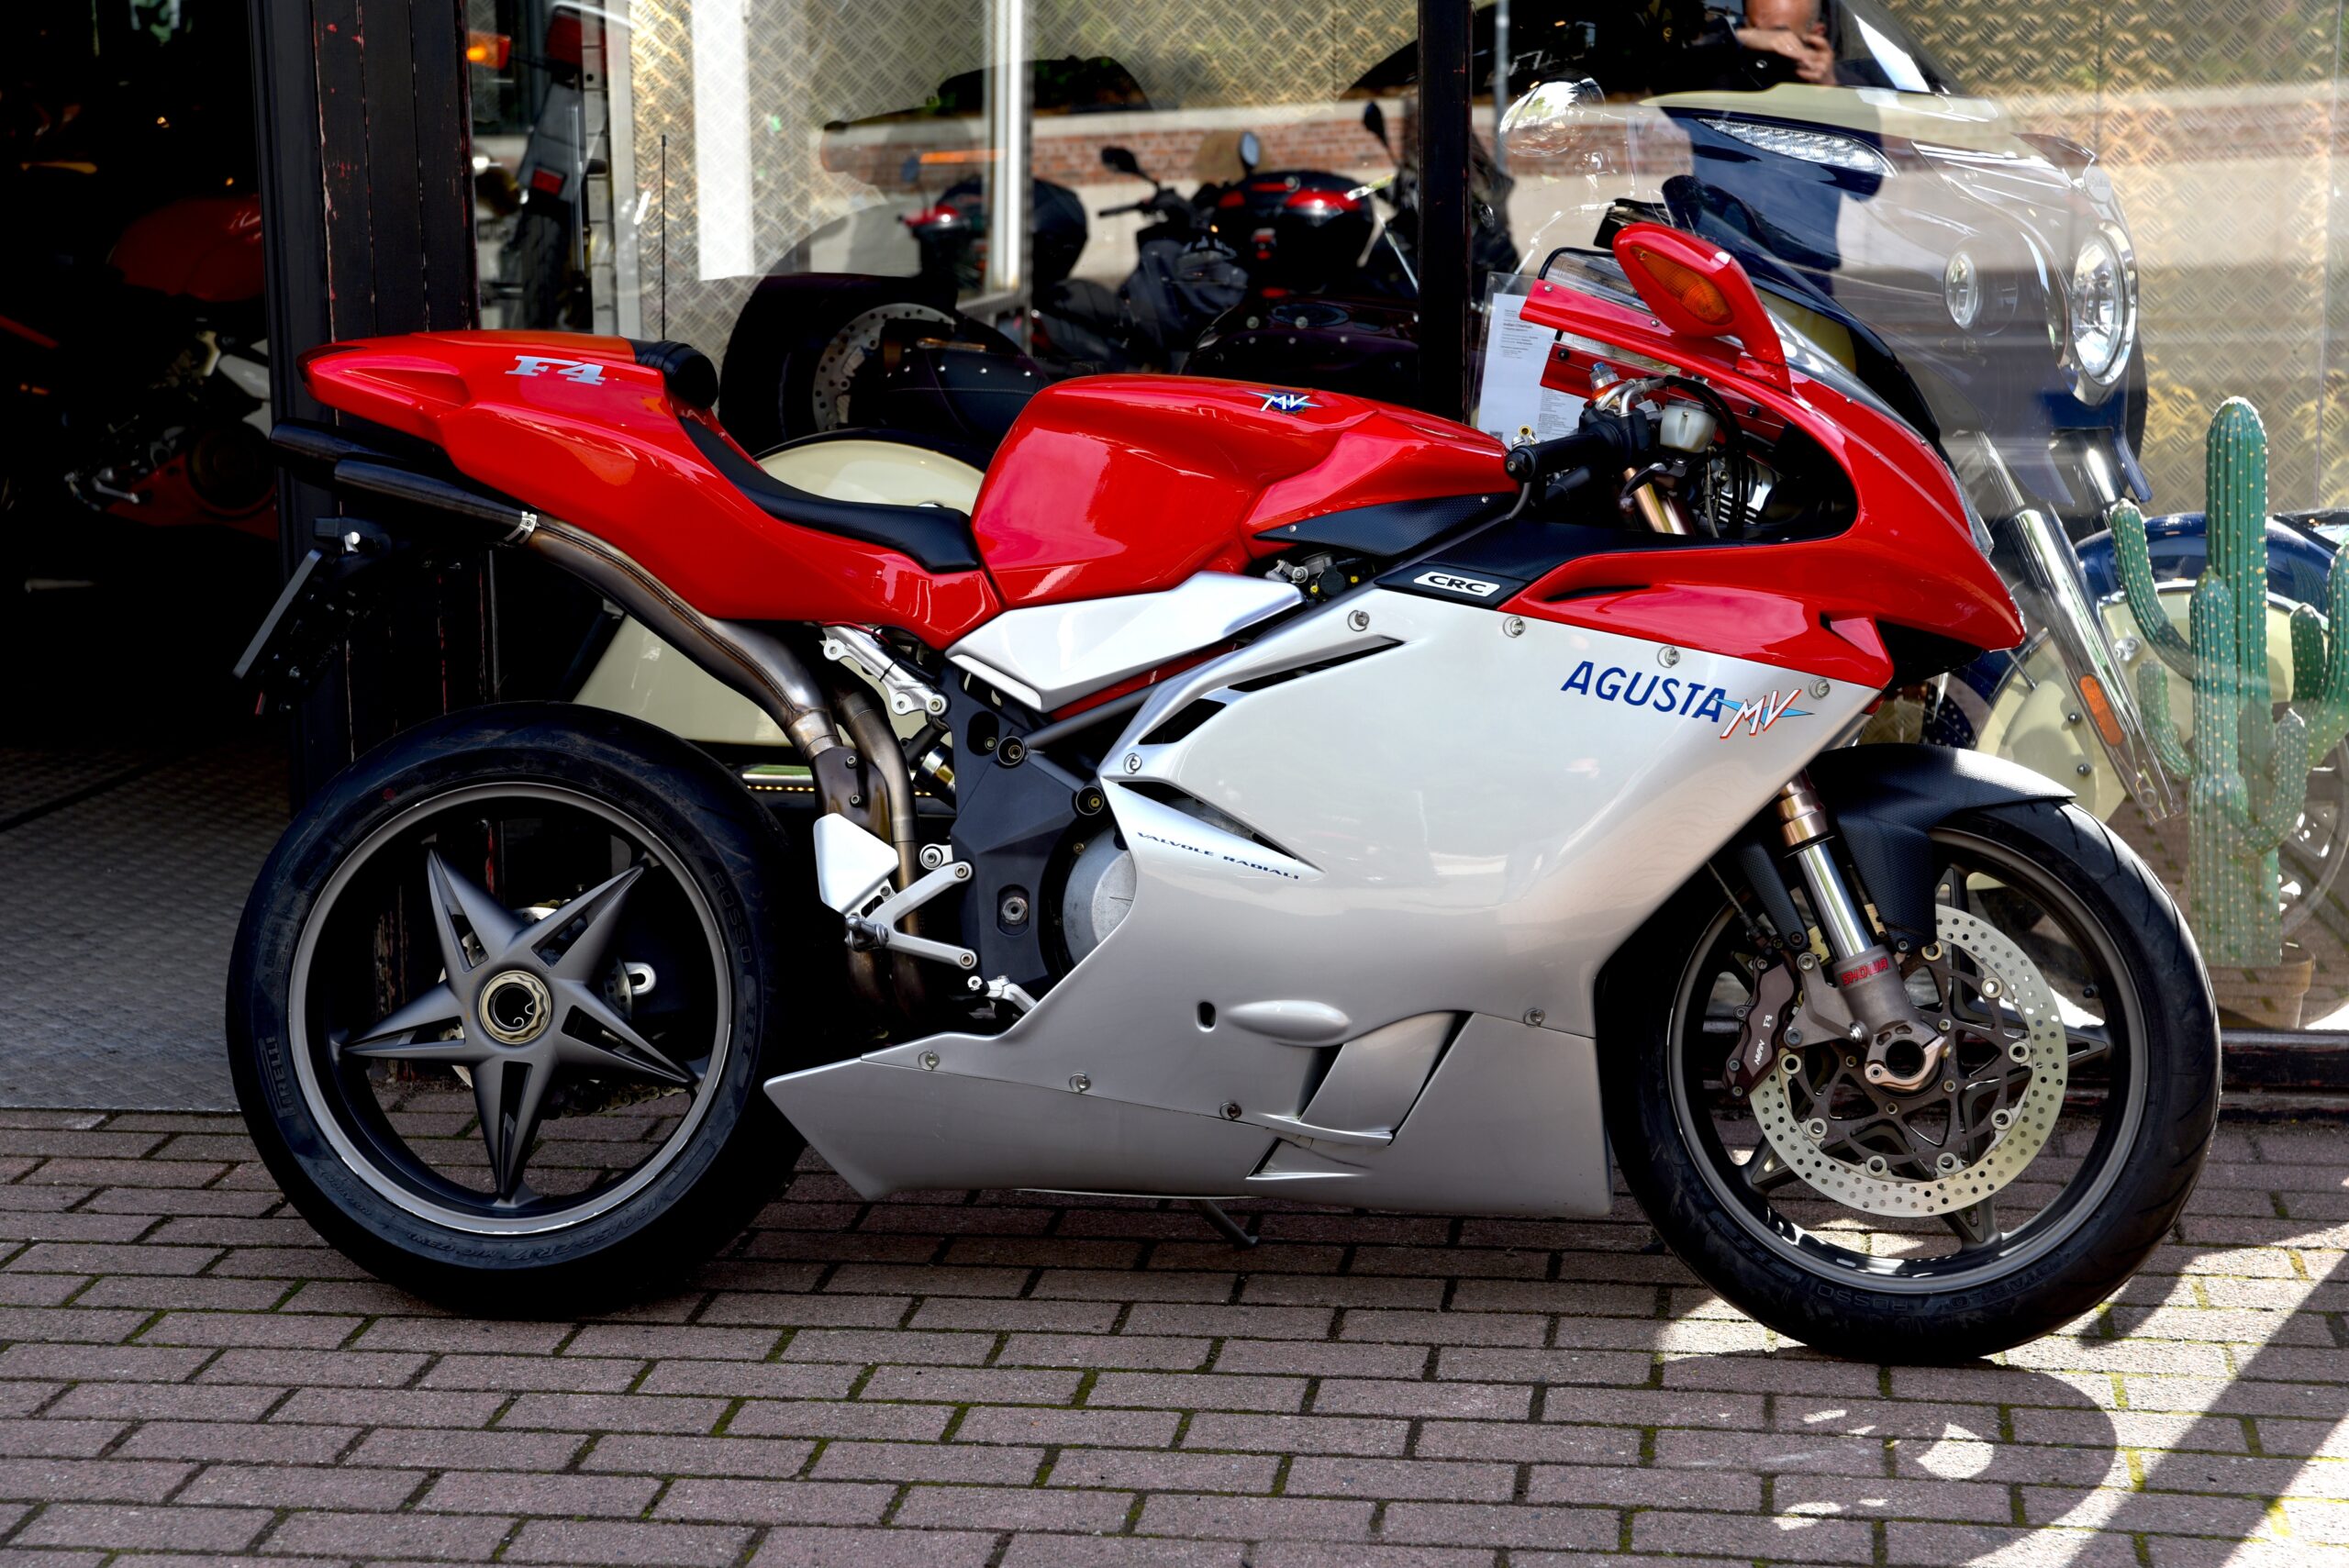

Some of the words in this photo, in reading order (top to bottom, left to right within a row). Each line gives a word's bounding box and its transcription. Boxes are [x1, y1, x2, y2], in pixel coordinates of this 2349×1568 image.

[505, 355, 607, 386] F4
[1260, 394, 1311, 412] MV
[1428, 575, 1487, 594] CRC
[1561, 660, 1727, 723] AGUSTA
[1719, 688, 1802, 740] MV
[1137, 831, 1215, 856] VALVOLE
[1223, 855, 1299, 880] RADIALI
[712, 871, 752, 964] ROSSO
[1841, 957, 1889, 986] SHOWA
[257, 1035, 296, 1119] PIRELLI
